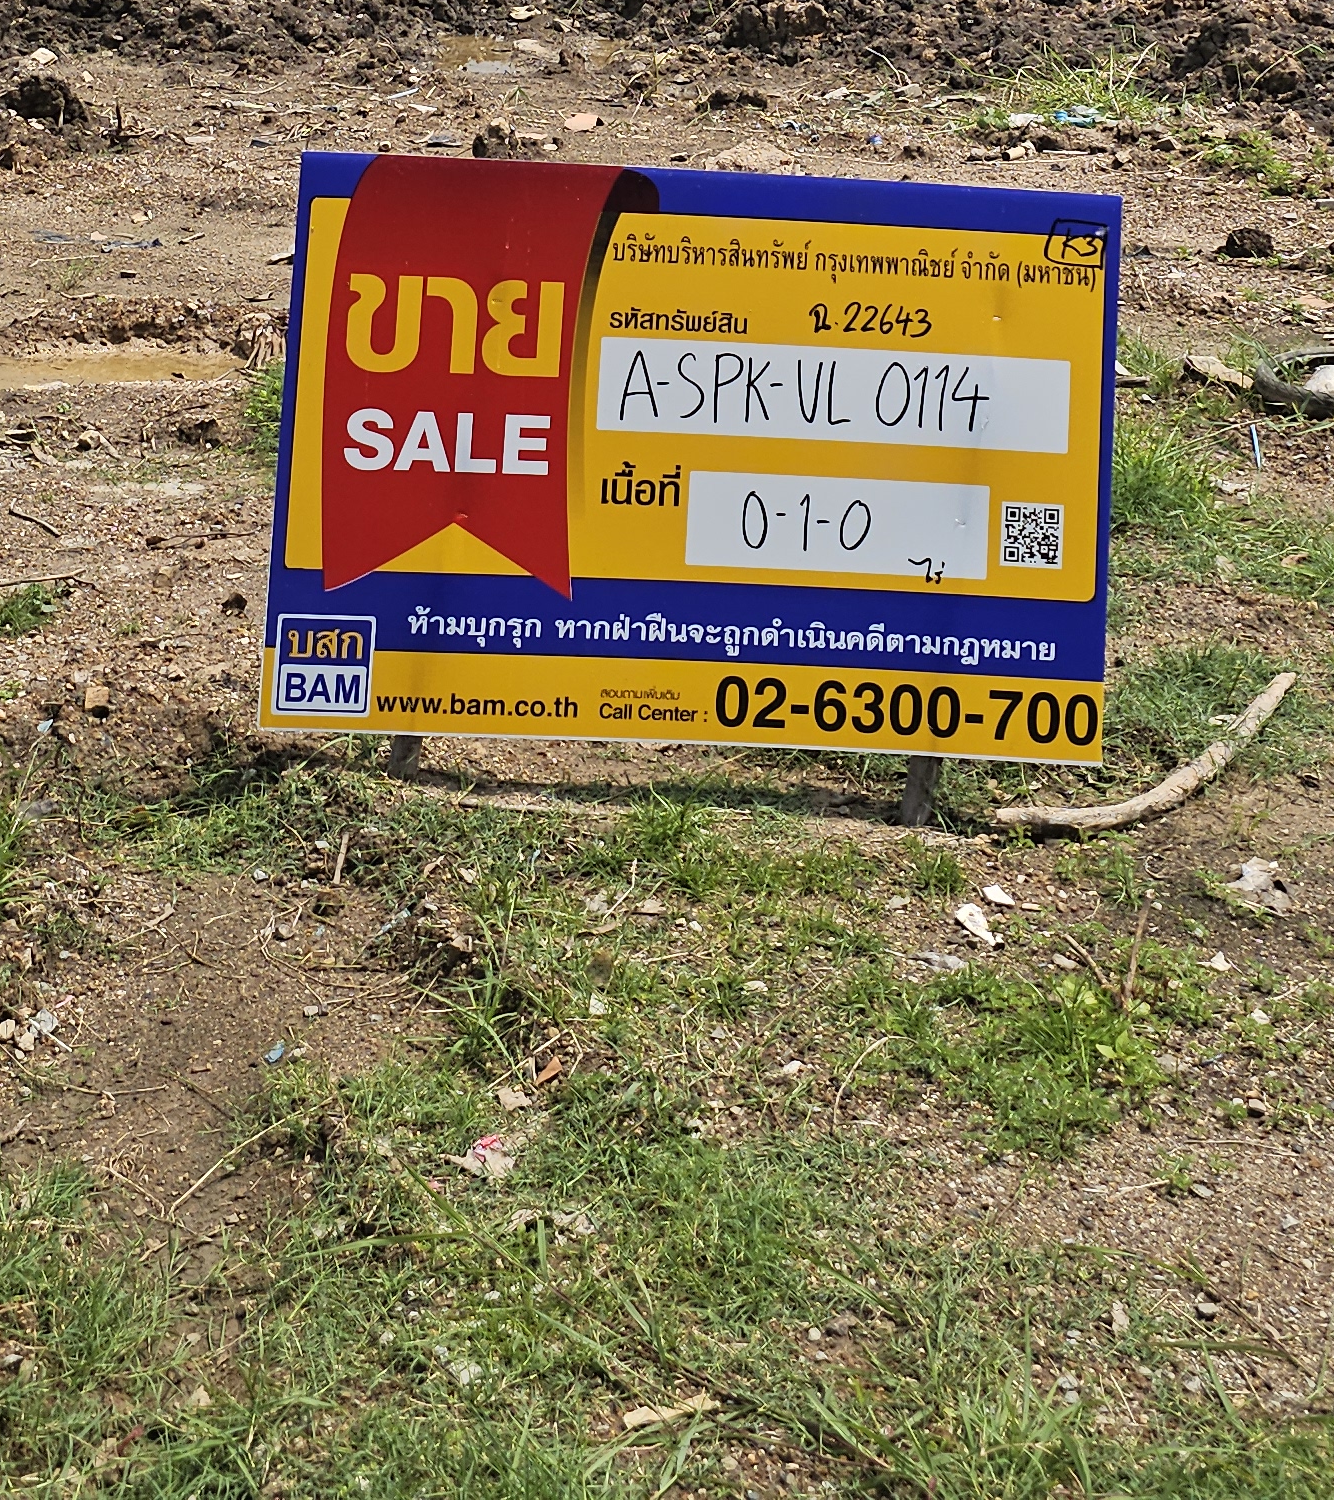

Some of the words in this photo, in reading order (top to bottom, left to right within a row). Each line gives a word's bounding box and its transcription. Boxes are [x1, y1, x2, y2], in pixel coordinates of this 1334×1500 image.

[612, 234, 810, 270] บริษัทบริหารสินทรัพย์
[814, 248, 958, 283] กรุงเทพพาณิชย์
[960, 251, 1010, 282] จำกัด
[1017, 261, 1096, 293] (มหาชน)
[1060, 228, 1100, 259] K3
[346, 273, 565, 378] ขาย
[609, 307, 748, 335] รหัสทรัพย์สิน
[875, 361, 990, 432] 0114
[343, 408, 552, 476] SALE
[600, 460, 682, 508] เนื้อที่
[741, 491, 872, 552] 0-1-0
[287, 627, 364, 661] บสก
[407, 605, 543, 648] ห้ามบุกรุก
[555, 611, 1057, 666] หากฝ่าฝืนจะถูกดำเนินคดีตามกฎหมาย
[284, 671, 362, 706] BAM
[375, 692, 579, 719] www.bam.co.th
[598, 702, 633, 720] Call
[637, 703, 699, 722] Center
[714, 675, 1099, 747] 02-6300-700
